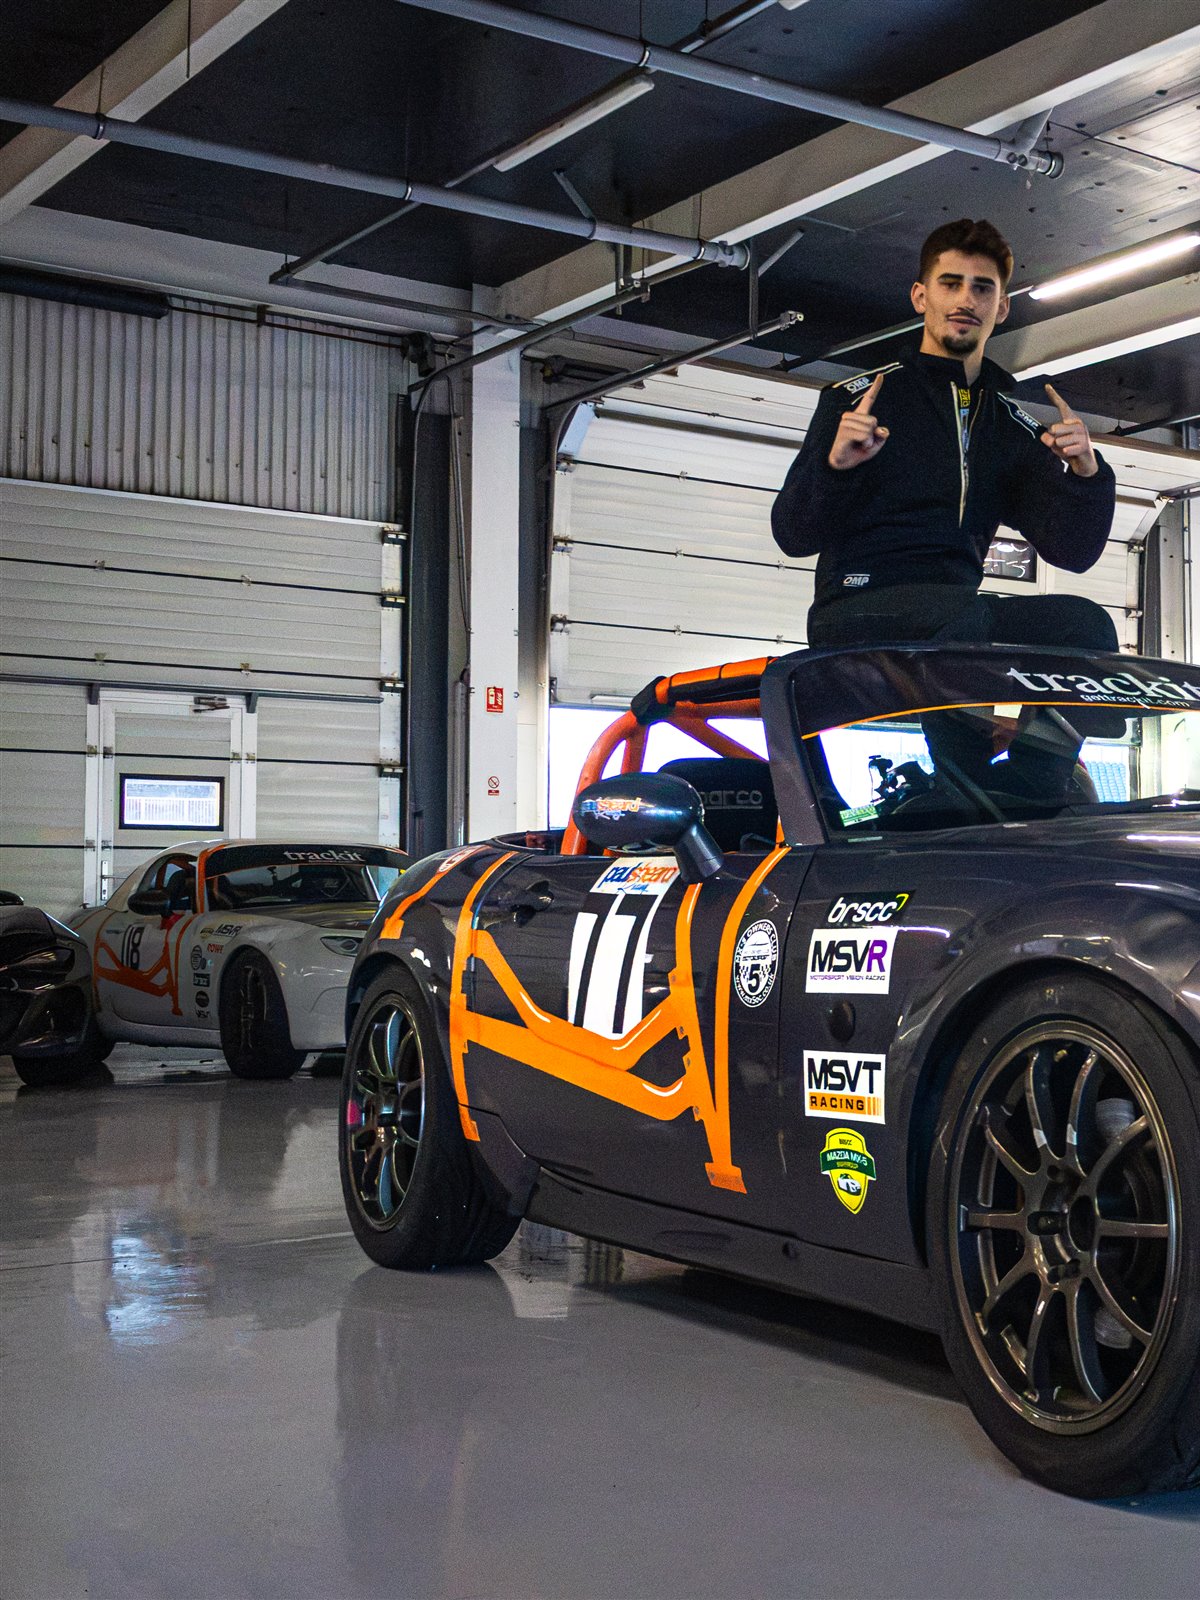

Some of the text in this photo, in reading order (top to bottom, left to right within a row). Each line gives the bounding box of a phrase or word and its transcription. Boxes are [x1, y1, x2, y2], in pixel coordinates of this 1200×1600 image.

[843, 576, 869, 586] OMP
[700, 790, 763, 804] arco
[283, 849, 367, 862] trackit
[828, 897, 898, 922] brscc
[811, 940, 888, 972] MSVR
[747, 963, 761, 993] 5
[808, 1059, 881, 1093] MSVT
[810, 1096, 865, 1111] RACING
[827, 1151, 850, 1161] MAZDA
[851, 1152, 868, 1166] MX-5
